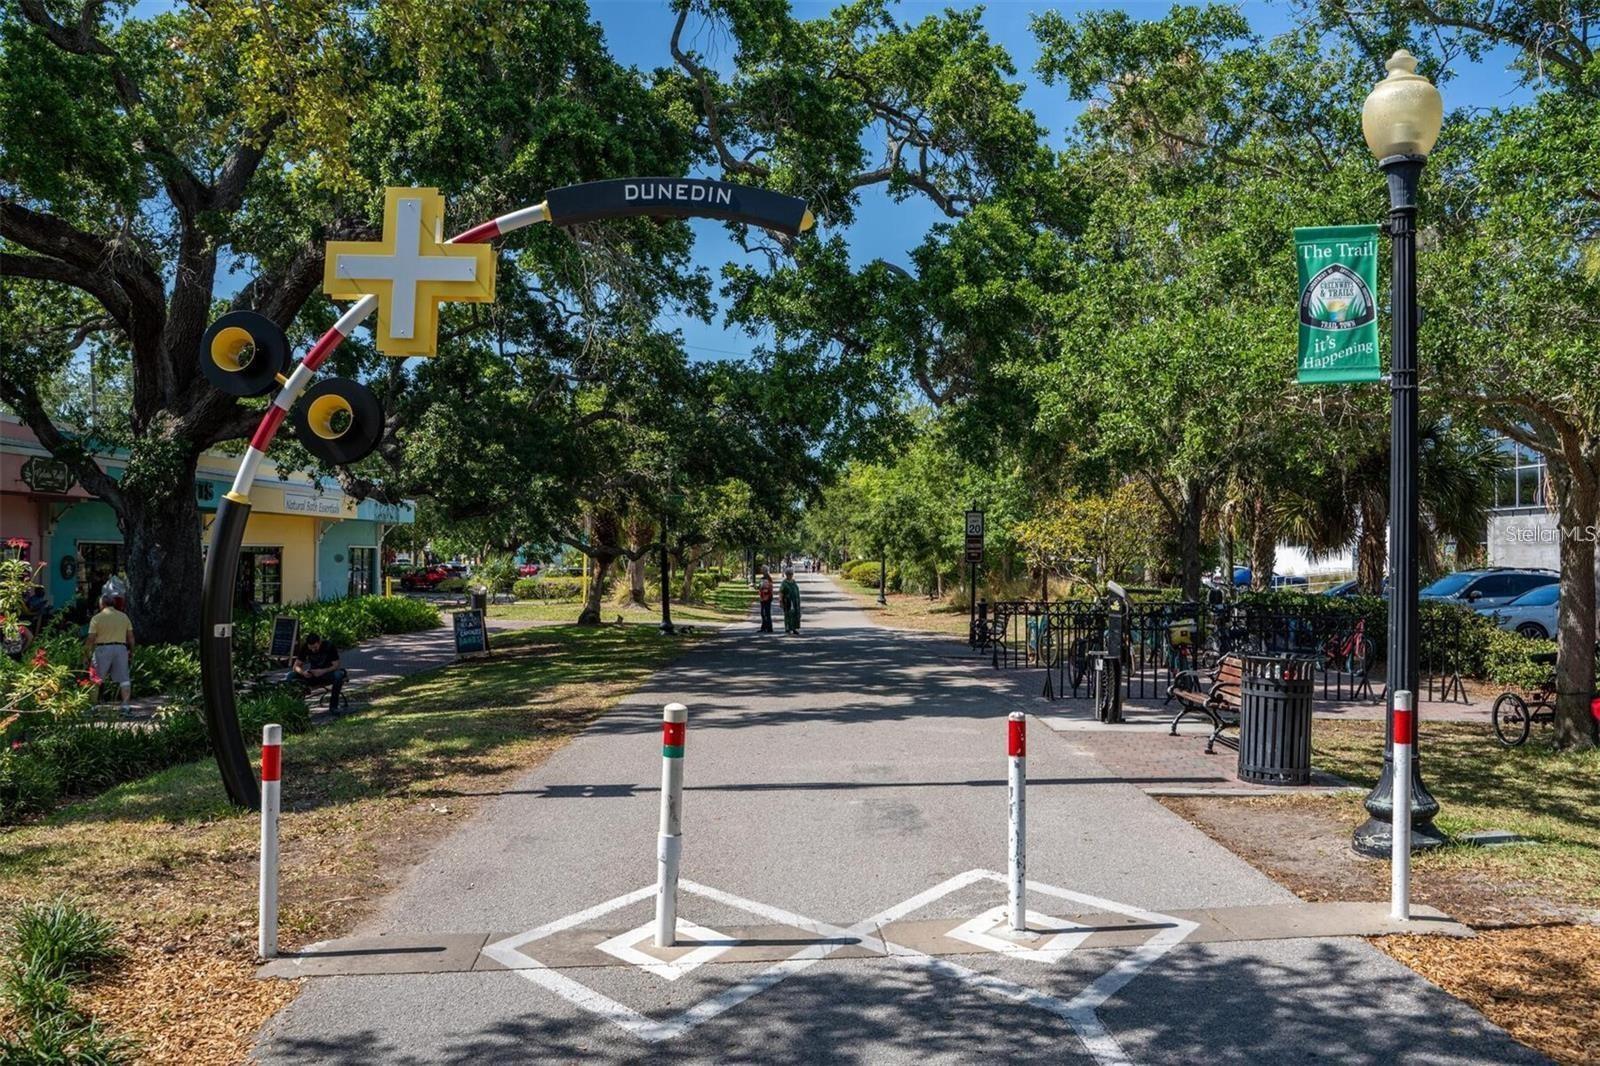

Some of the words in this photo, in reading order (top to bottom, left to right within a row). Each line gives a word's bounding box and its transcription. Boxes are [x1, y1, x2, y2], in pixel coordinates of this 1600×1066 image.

[624, 184, 732, 205] DUNEDIN
[1299, 244, 1332, 259] The
[1336, 241, 1374, 257] Trail
[1320, 289, 1325, 297] &
[1329, 289, 1354, 297] TRAILS
[1320, 321, 1338, 329] TRAIL
[1339, 320, 1356, 329] TOWN
[1314, 336, 1336, 353] it's
[1303, 342, 1374, 369] Happening
[286, 500, 305, 511] Natural
[306, 500, 318, 512] Bath
[319, 502, 339, 513] Essentials
[969, 524, 981, 534] 20
